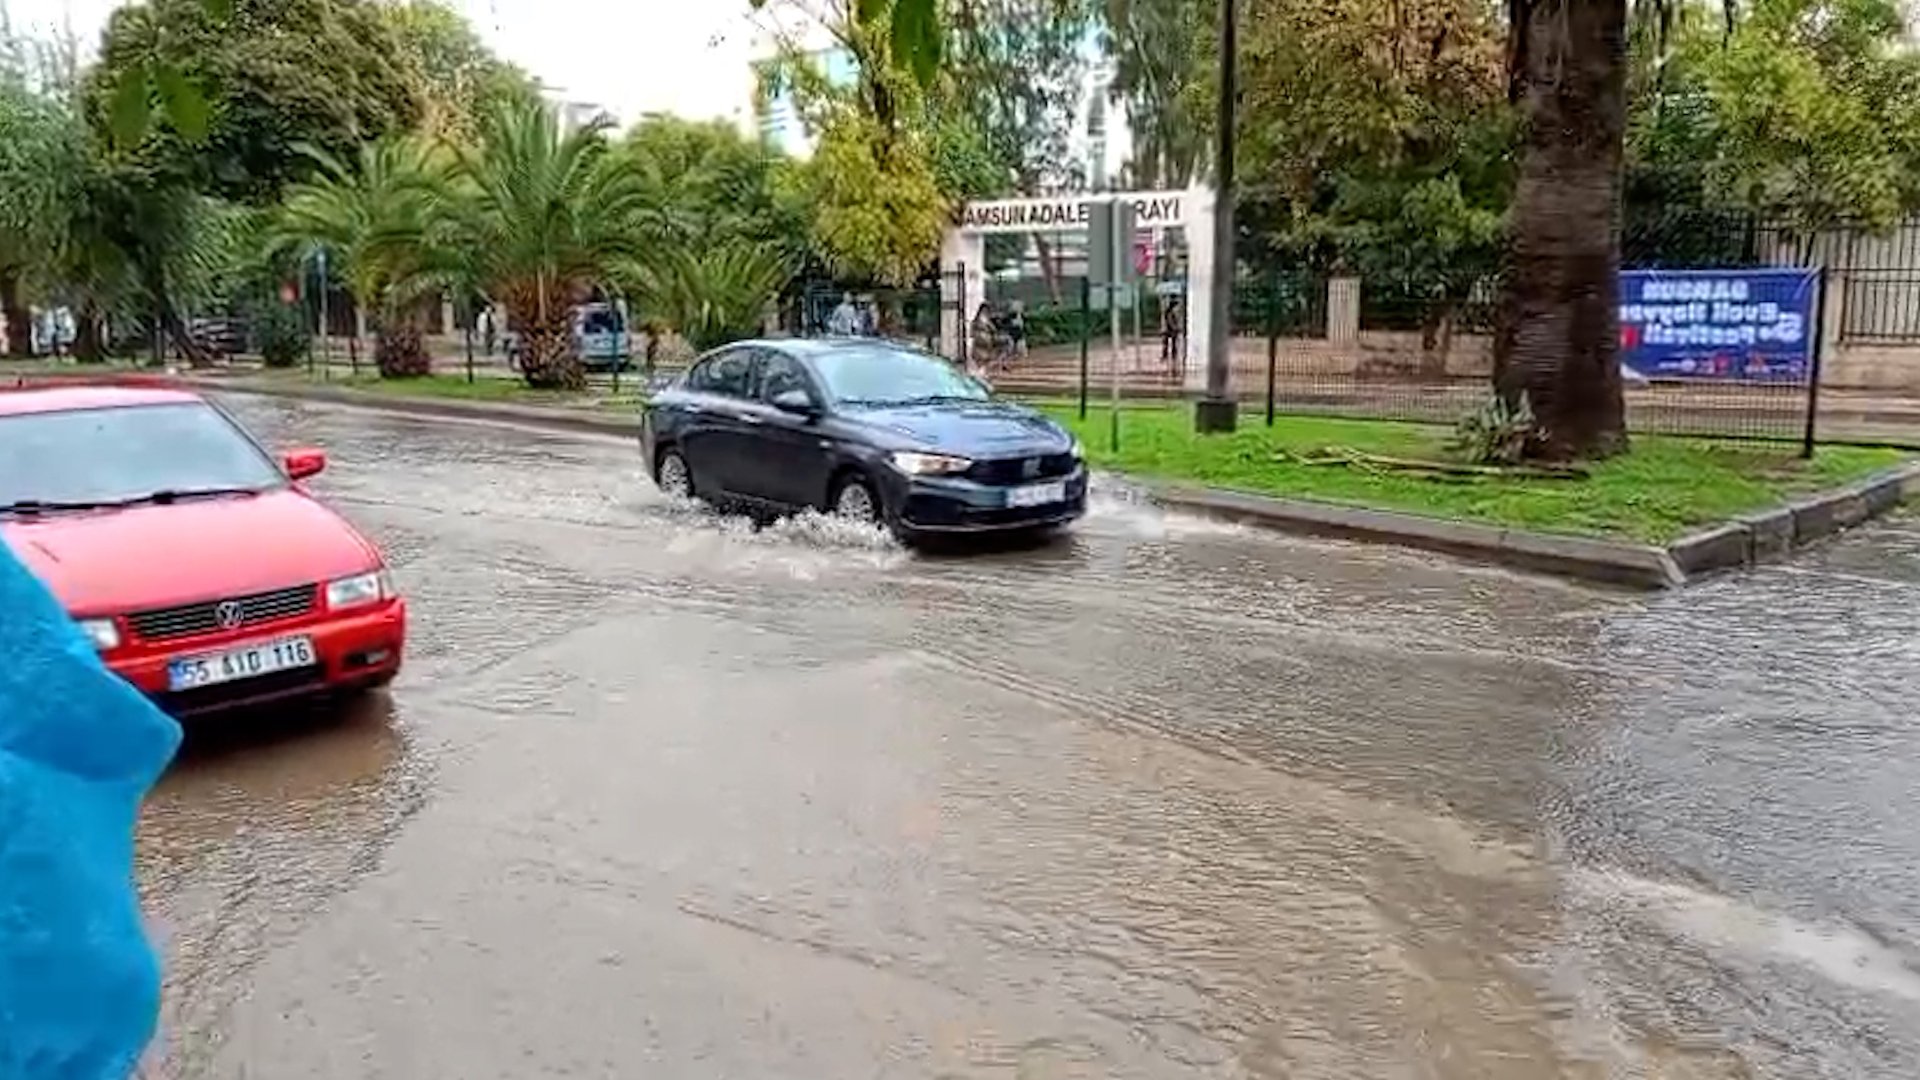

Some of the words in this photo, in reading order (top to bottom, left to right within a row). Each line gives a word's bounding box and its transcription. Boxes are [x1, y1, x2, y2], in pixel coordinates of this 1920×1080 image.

[957, 205, 1027, 226] AMSUN
[1029, 203, 1089, 225] ADALE
[1134, 199, 1180, 220] RAYI
[273, 641, 310, 666] 116
